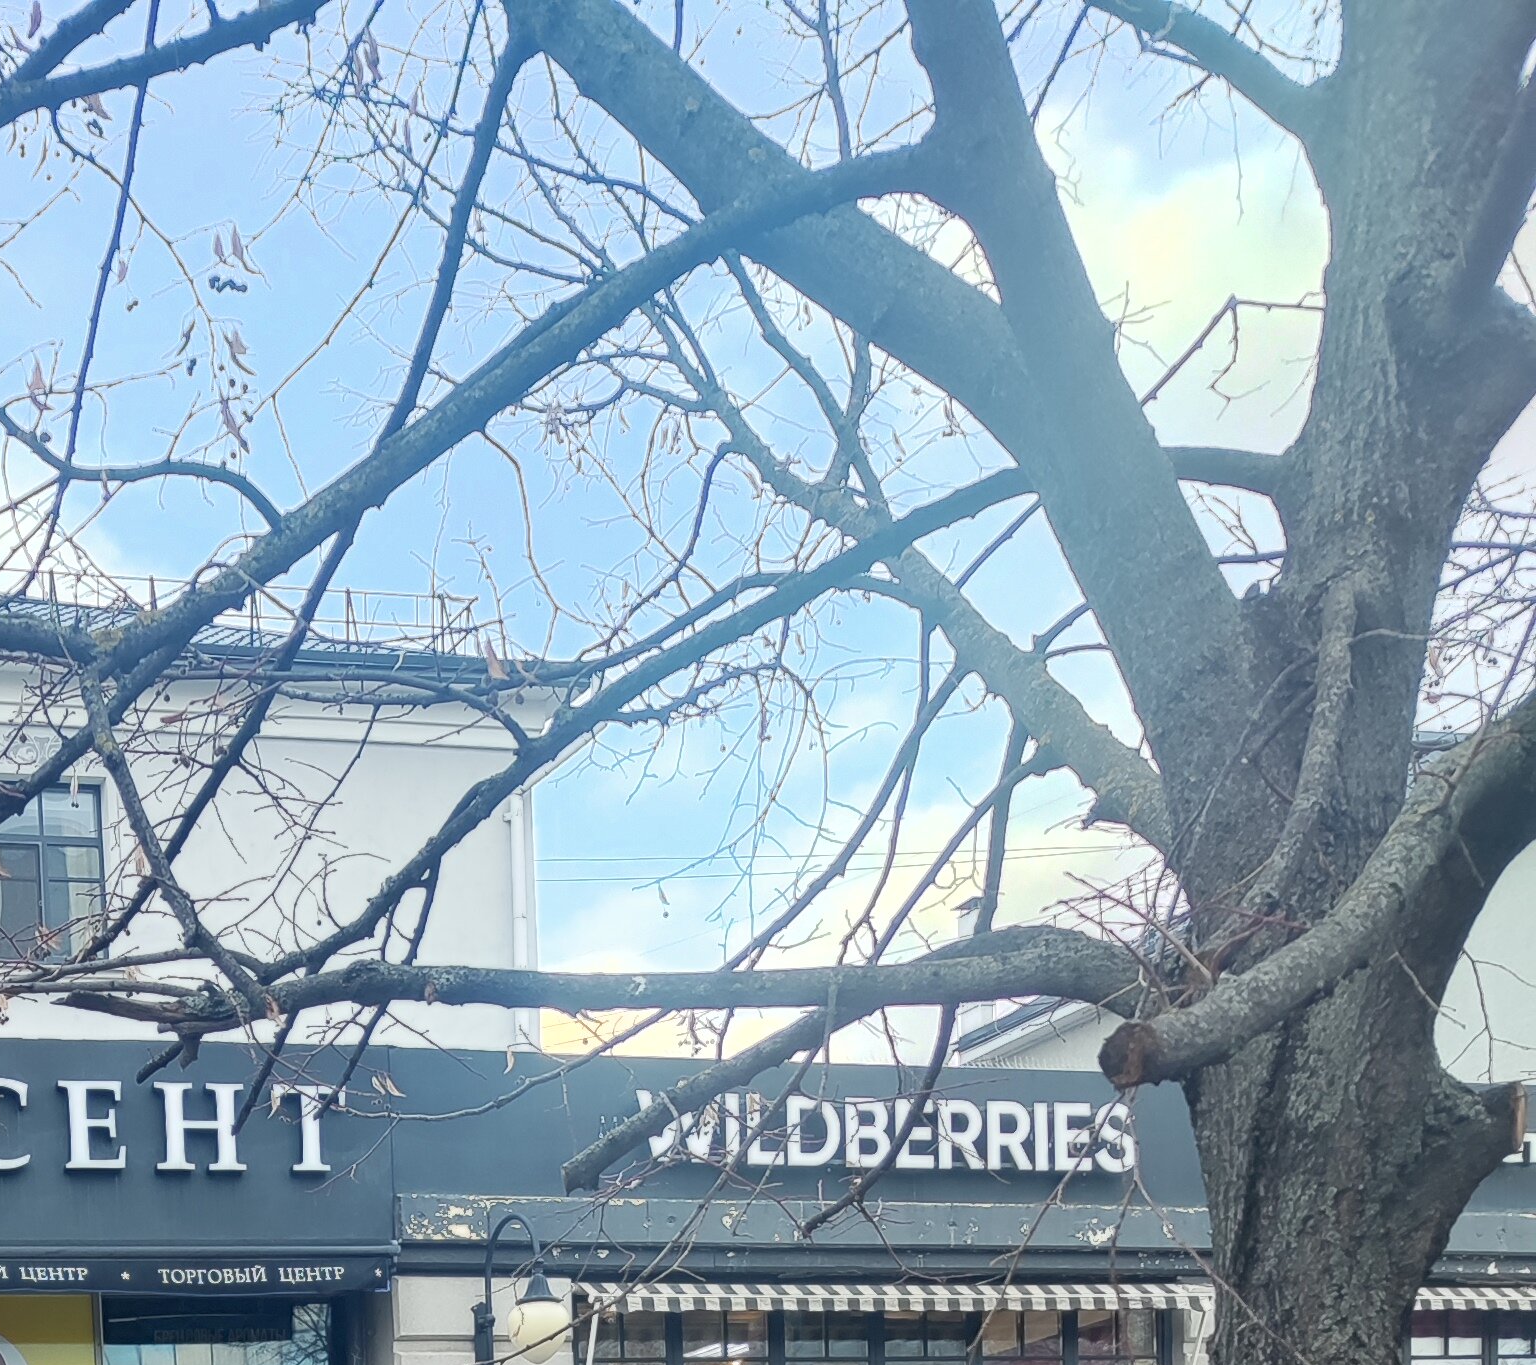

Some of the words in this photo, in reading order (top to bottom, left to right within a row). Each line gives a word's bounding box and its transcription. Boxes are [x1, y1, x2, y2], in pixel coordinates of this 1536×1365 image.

[19, 1266, 88, 1282] ЦЕНТР
[158, 1265, 267, 1284] ТОРГОВЫЙ
[279, 1266, 345, 1282] ЦЕНТР
